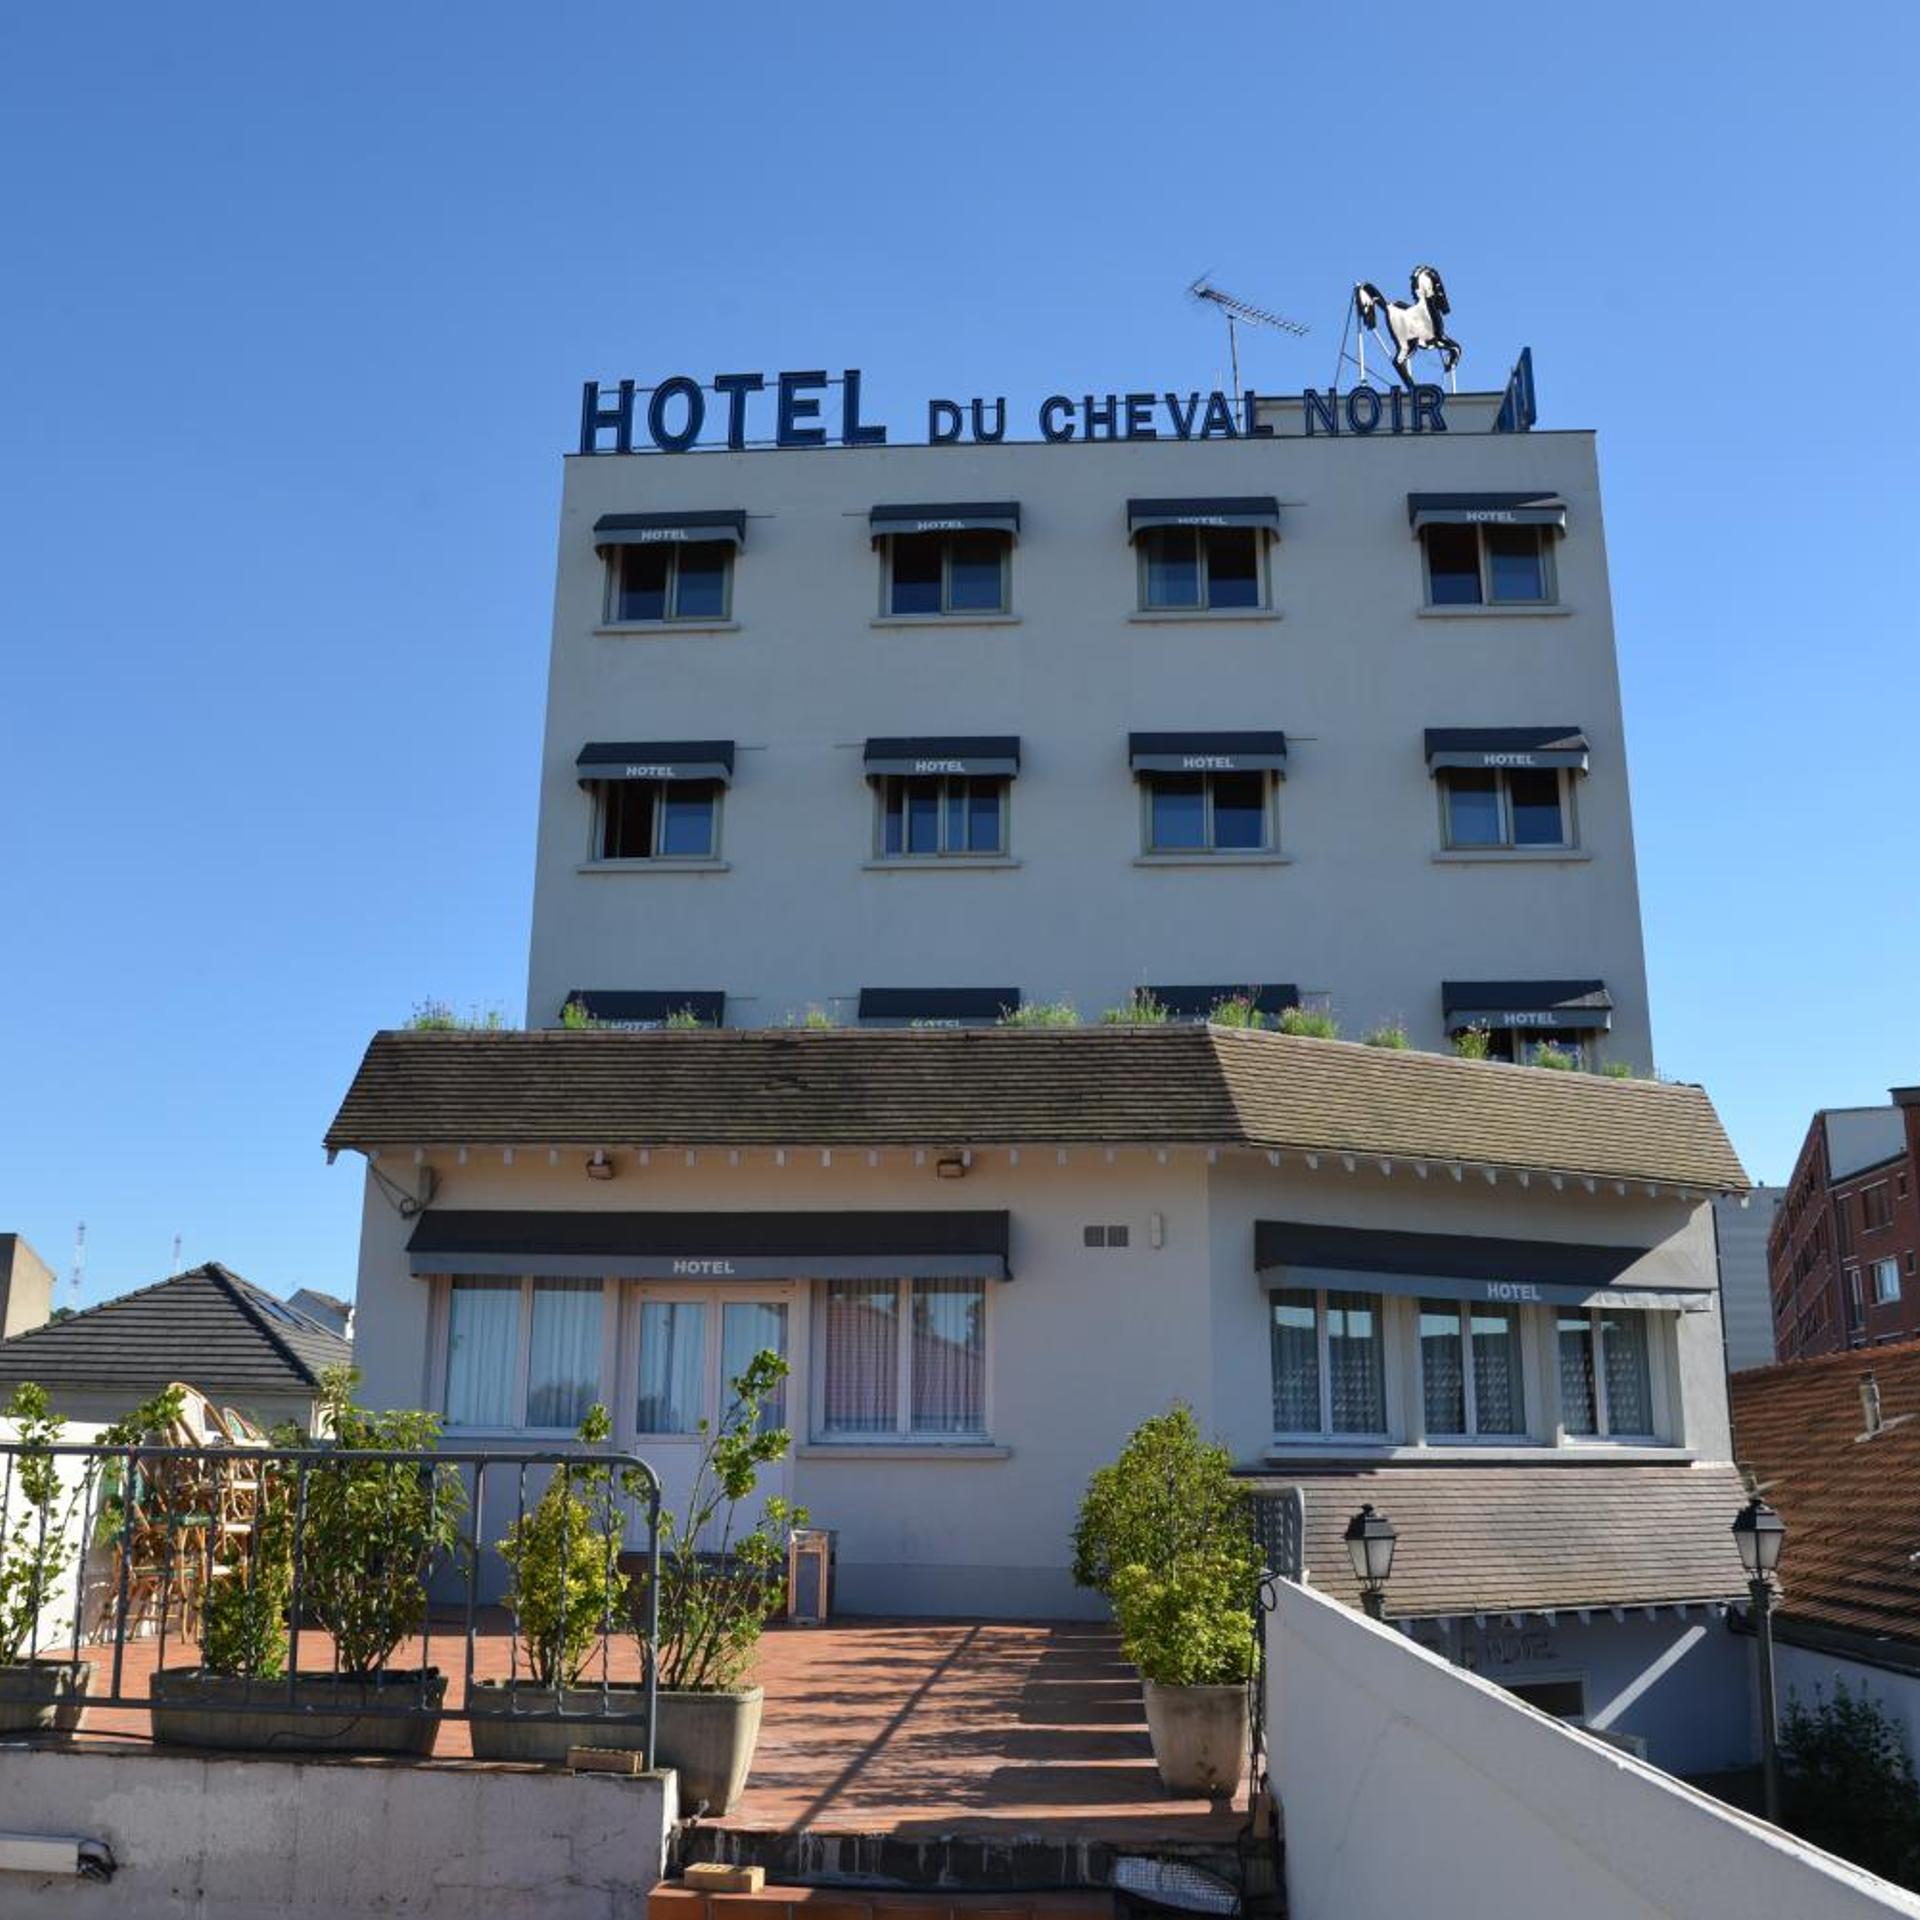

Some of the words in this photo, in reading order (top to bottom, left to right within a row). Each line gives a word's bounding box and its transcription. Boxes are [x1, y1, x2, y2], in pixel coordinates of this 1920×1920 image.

[582, 369, 887, 455] HOTEL
[929, 397, 1006, 444] DU
[1039, 390, 1274, 442] CHEVAL
[1303, 384, 1449, 437] NOIR
[1466, 511, 1516, 523] HOTEL
[917, 520, 966, 531] HOTEL
[641, 529, 689, 541] HOTEL
[1183, 756, 1234, 769] HOTEL
[1483, 753, 1535, 766] HOTEL
[625, 765, 675, 777] HOTEL
[914, 760, 965, 773] HOTEL
[1503, 1012, 1557, 1026] HOTEL
[673, 1260, 735, 1275] HOTEL
[1486, 1282, 1541, 1302] HOTEL
